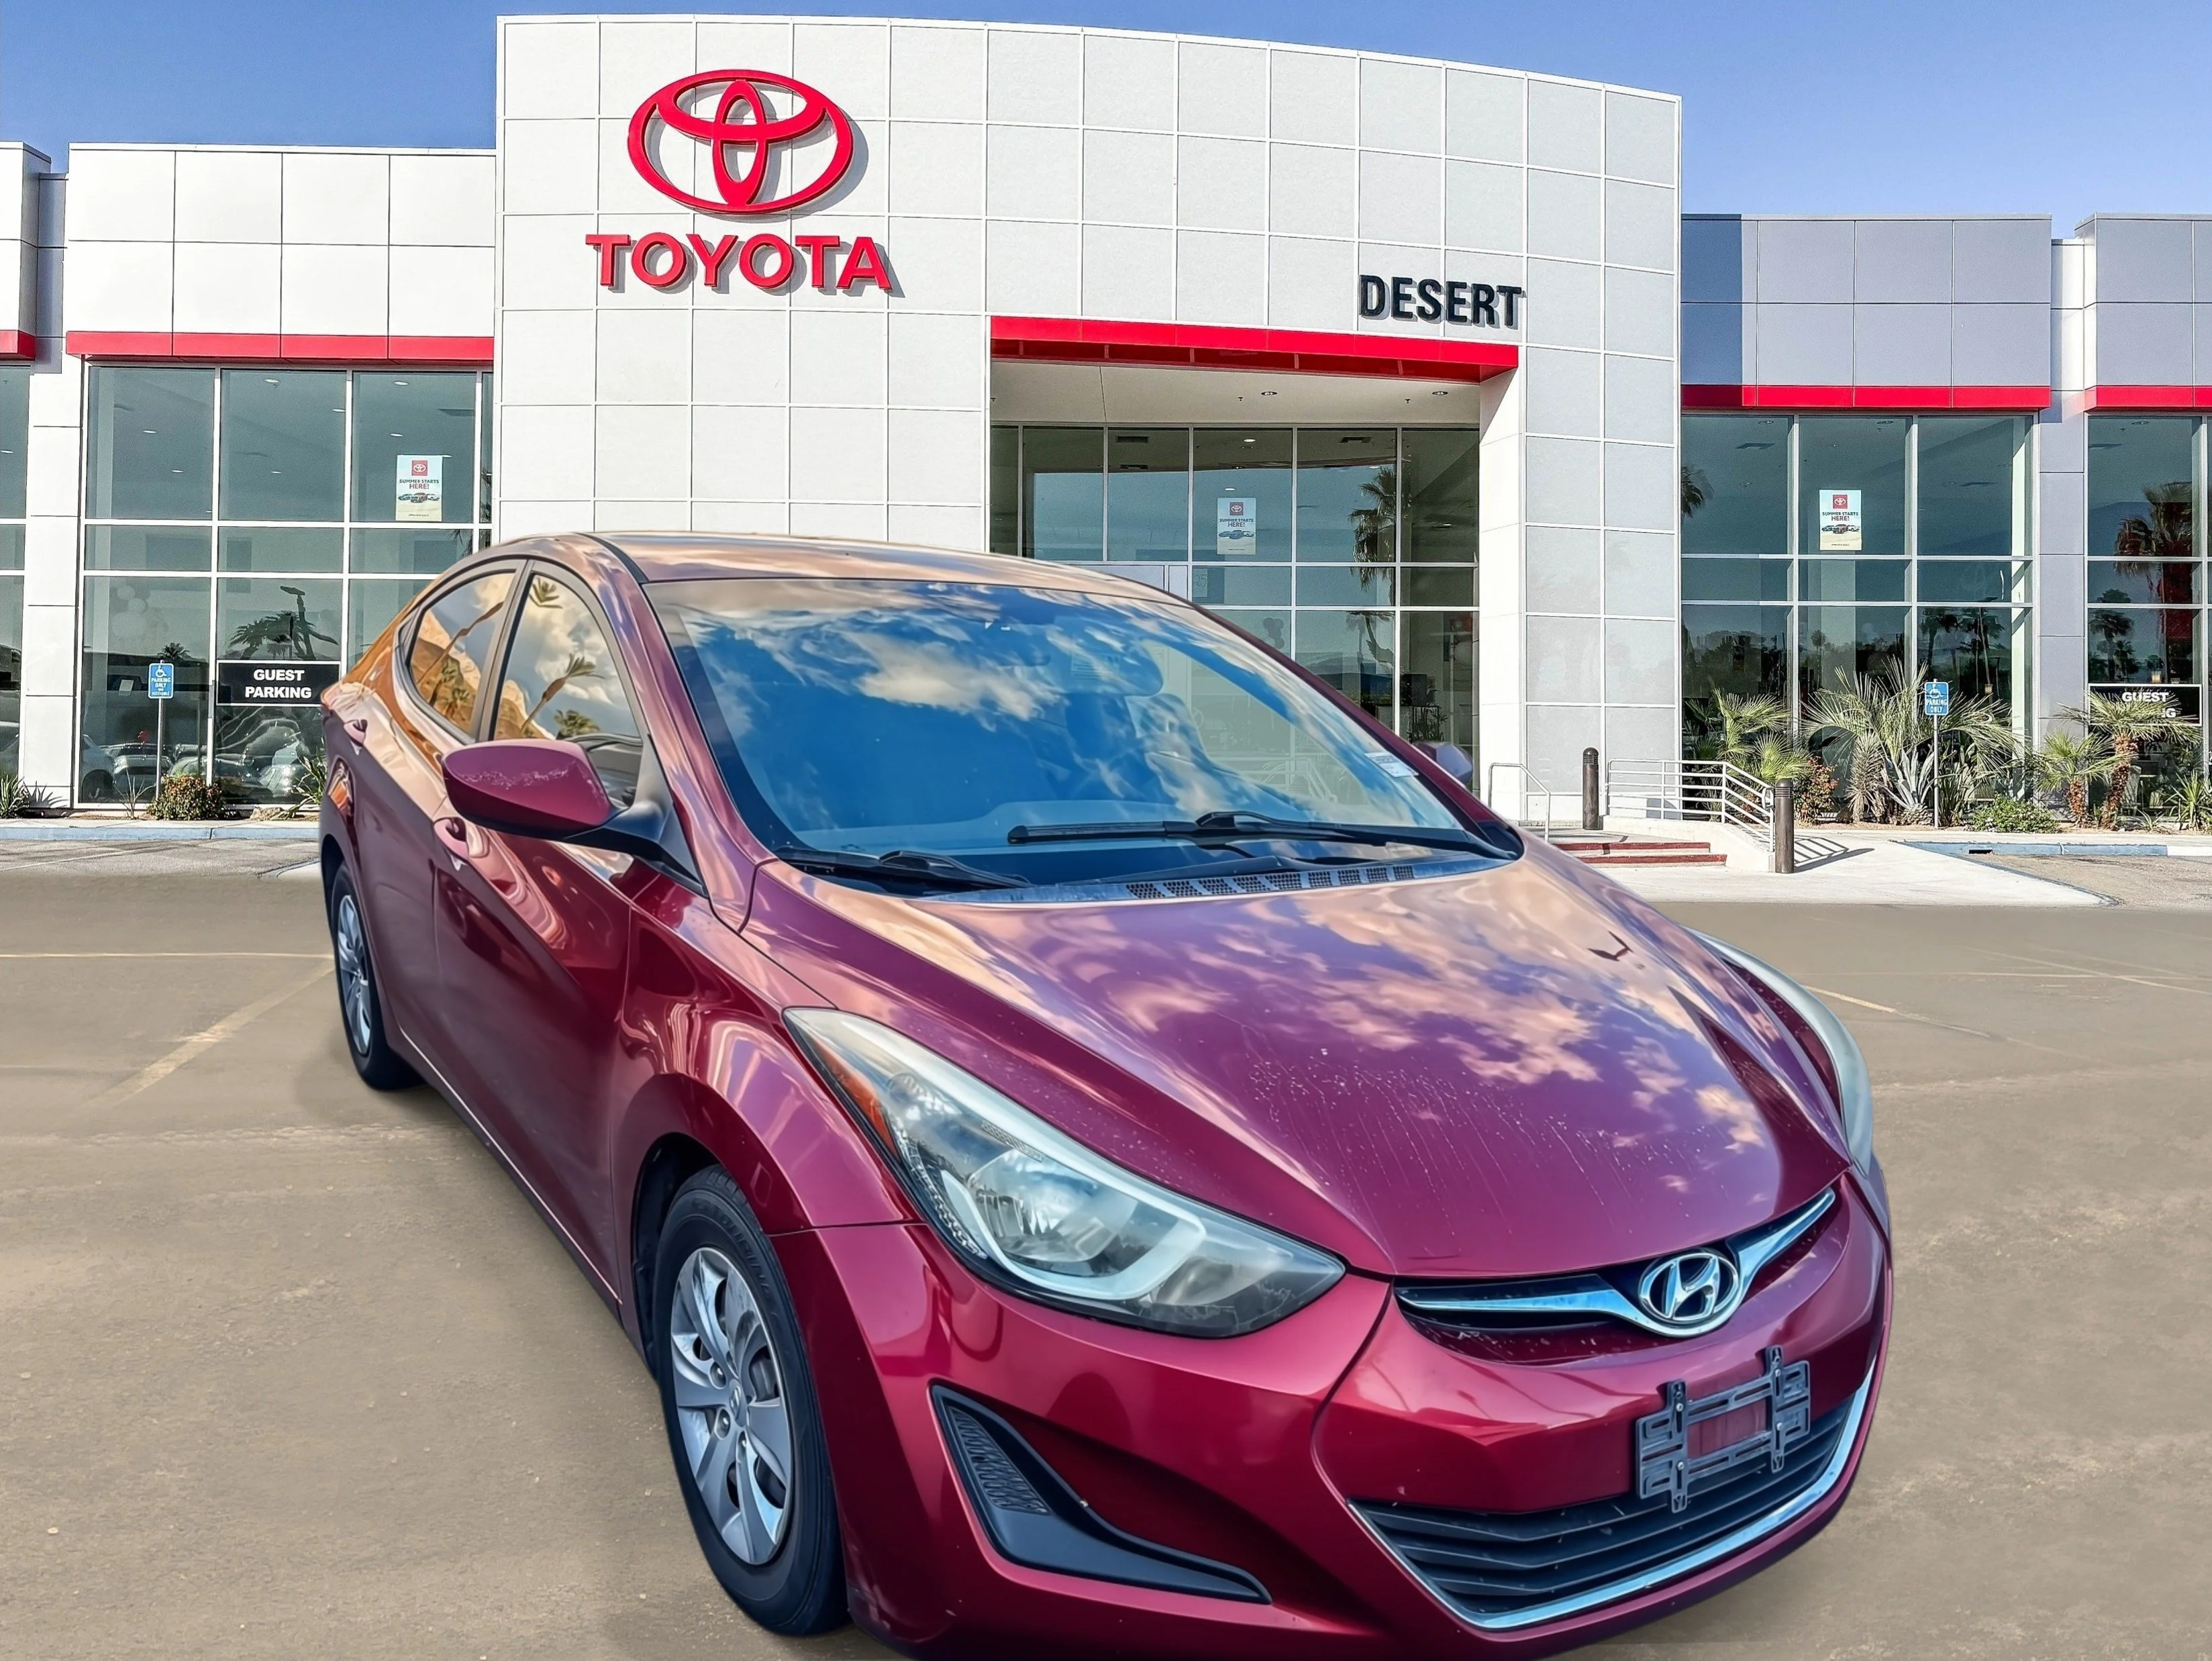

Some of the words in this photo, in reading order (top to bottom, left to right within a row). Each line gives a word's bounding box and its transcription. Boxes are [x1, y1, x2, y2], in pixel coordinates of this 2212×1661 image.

[586, 232, 892, 290] TOYOTA
[1359, 274, 1521, 326] DESERT
[253, 669, 305, 681] GUEST
[245, 687, 311, 699] PARKING
[2121, 691, 2169, 702] GUEST
